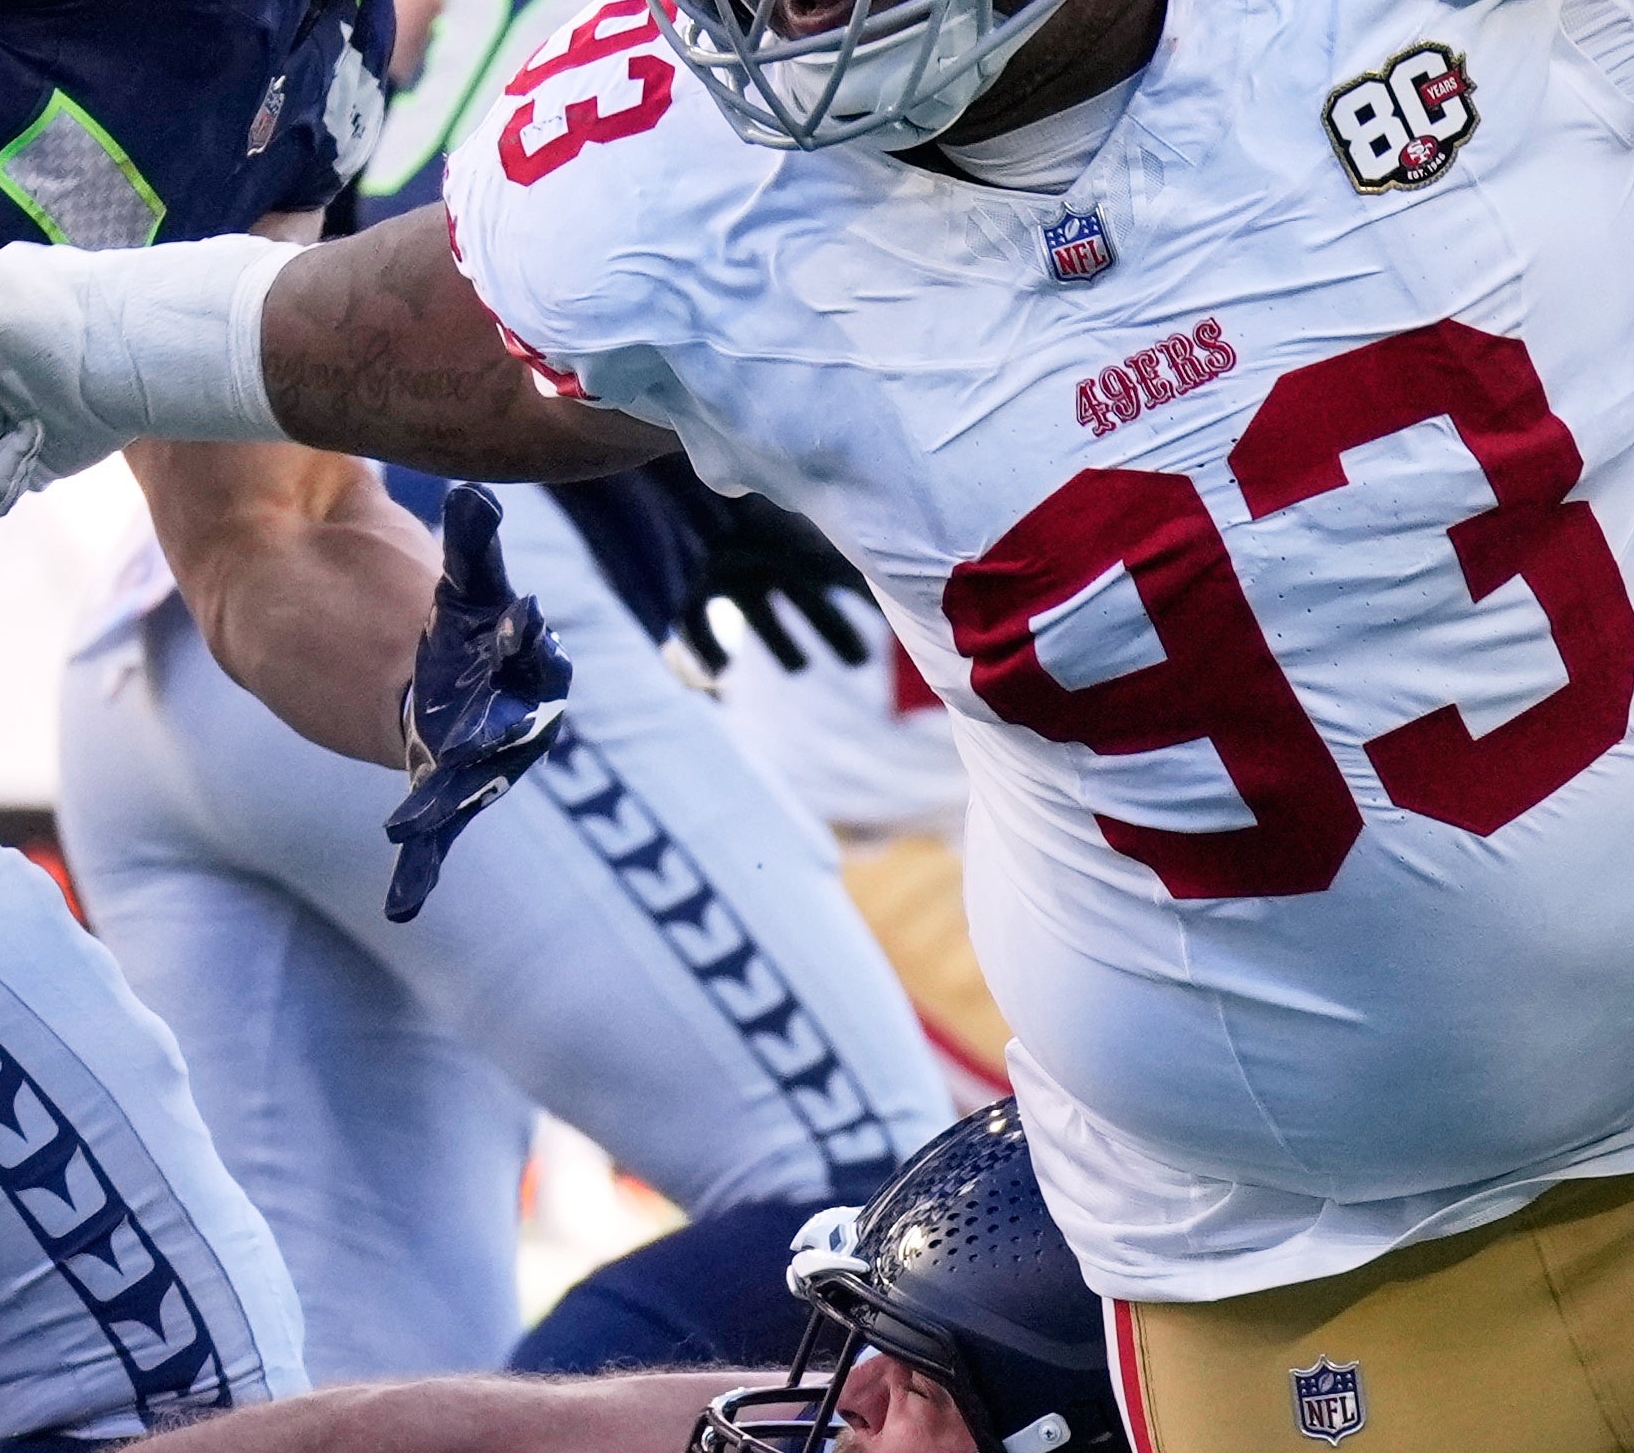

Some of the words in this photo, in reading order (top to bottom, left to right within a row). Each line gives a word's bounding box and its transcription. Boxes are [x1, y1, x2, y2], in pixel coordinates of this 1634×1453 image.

[1426, 75, 1459, 101] YEARS
[1054, 239, 1107, 277] NFL
[1074, 316, 1238, 438] 49ERS
[1304, 1395, 1356, 1430] NFL
